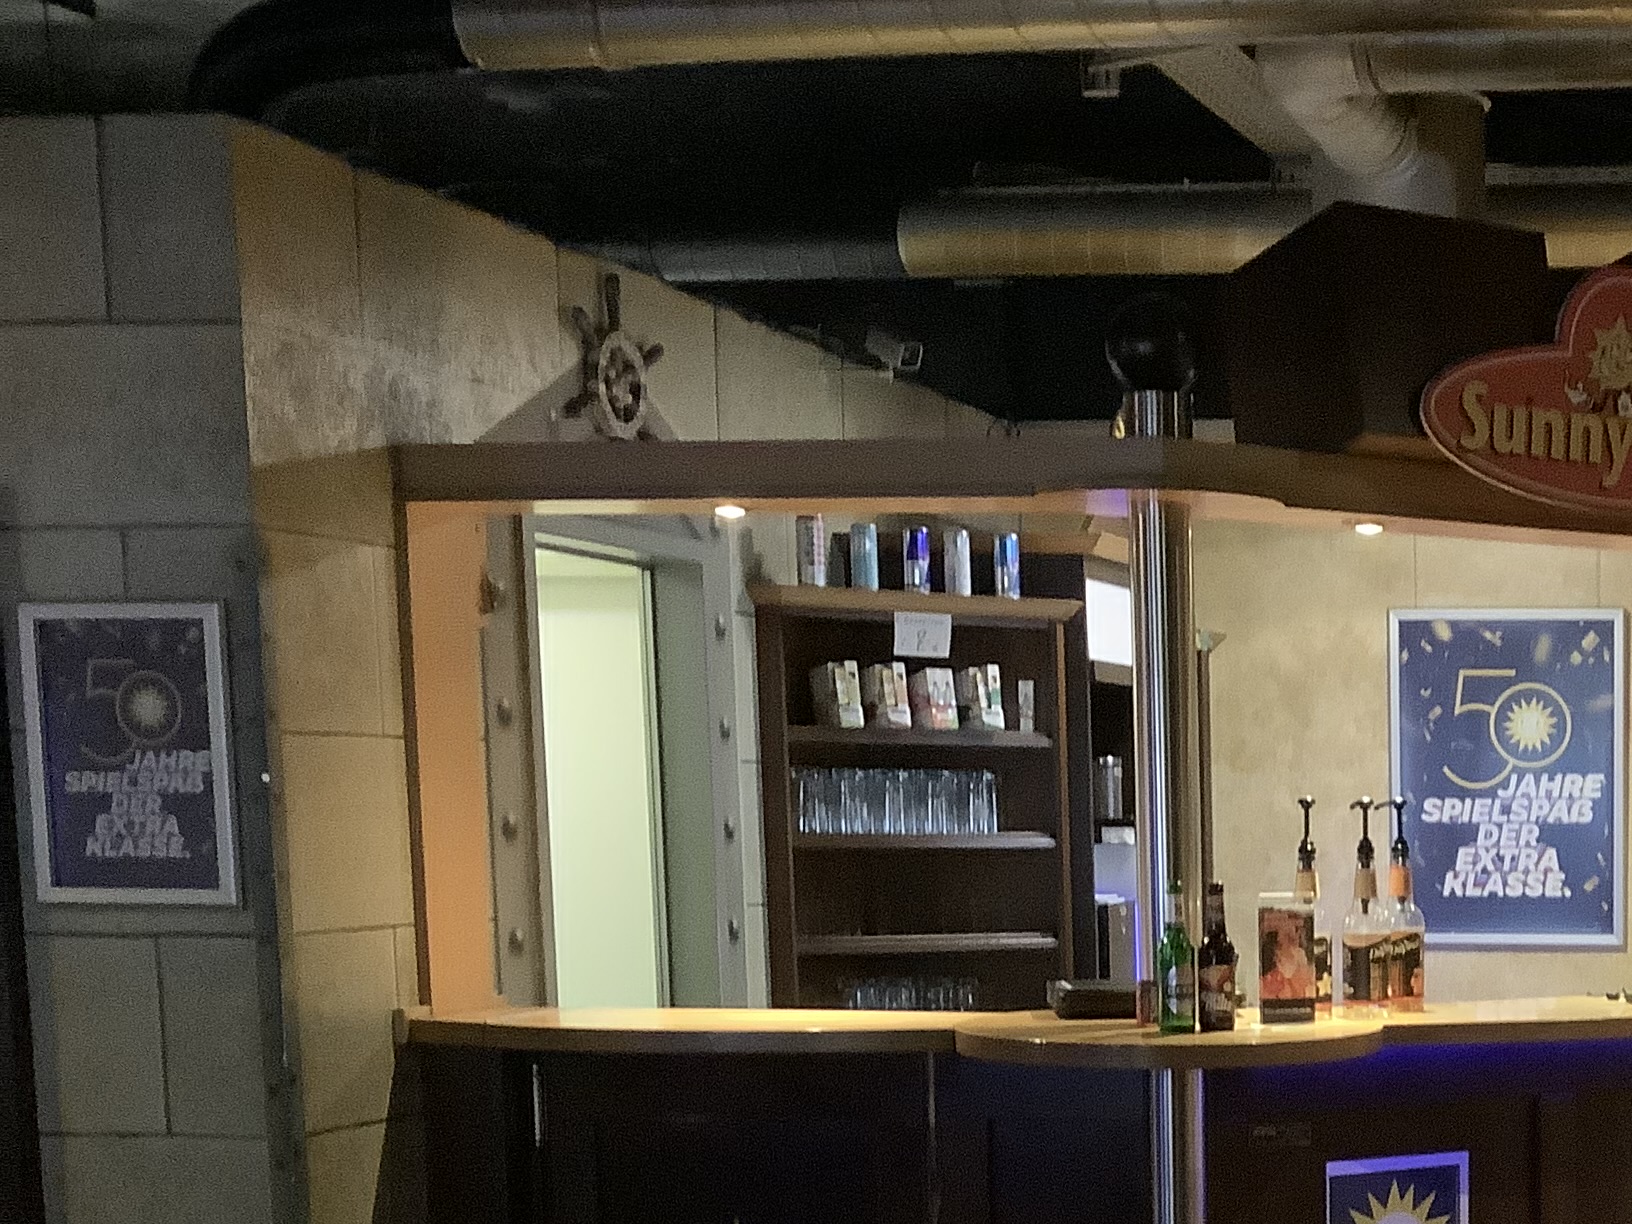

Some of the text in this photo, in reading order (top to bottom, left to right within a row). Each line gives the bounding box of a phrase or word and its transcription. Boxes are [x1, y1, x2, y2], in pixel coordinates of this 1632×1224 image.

[1442, 668, 1572, 789] 50
[1497, 773, 1605, 801] JAHRE
[1476, 823, 1540, 848] DER
[1454, 846, 1560, 874] EXTRA
[1442, 871, 1573, 899] KLASSE.
